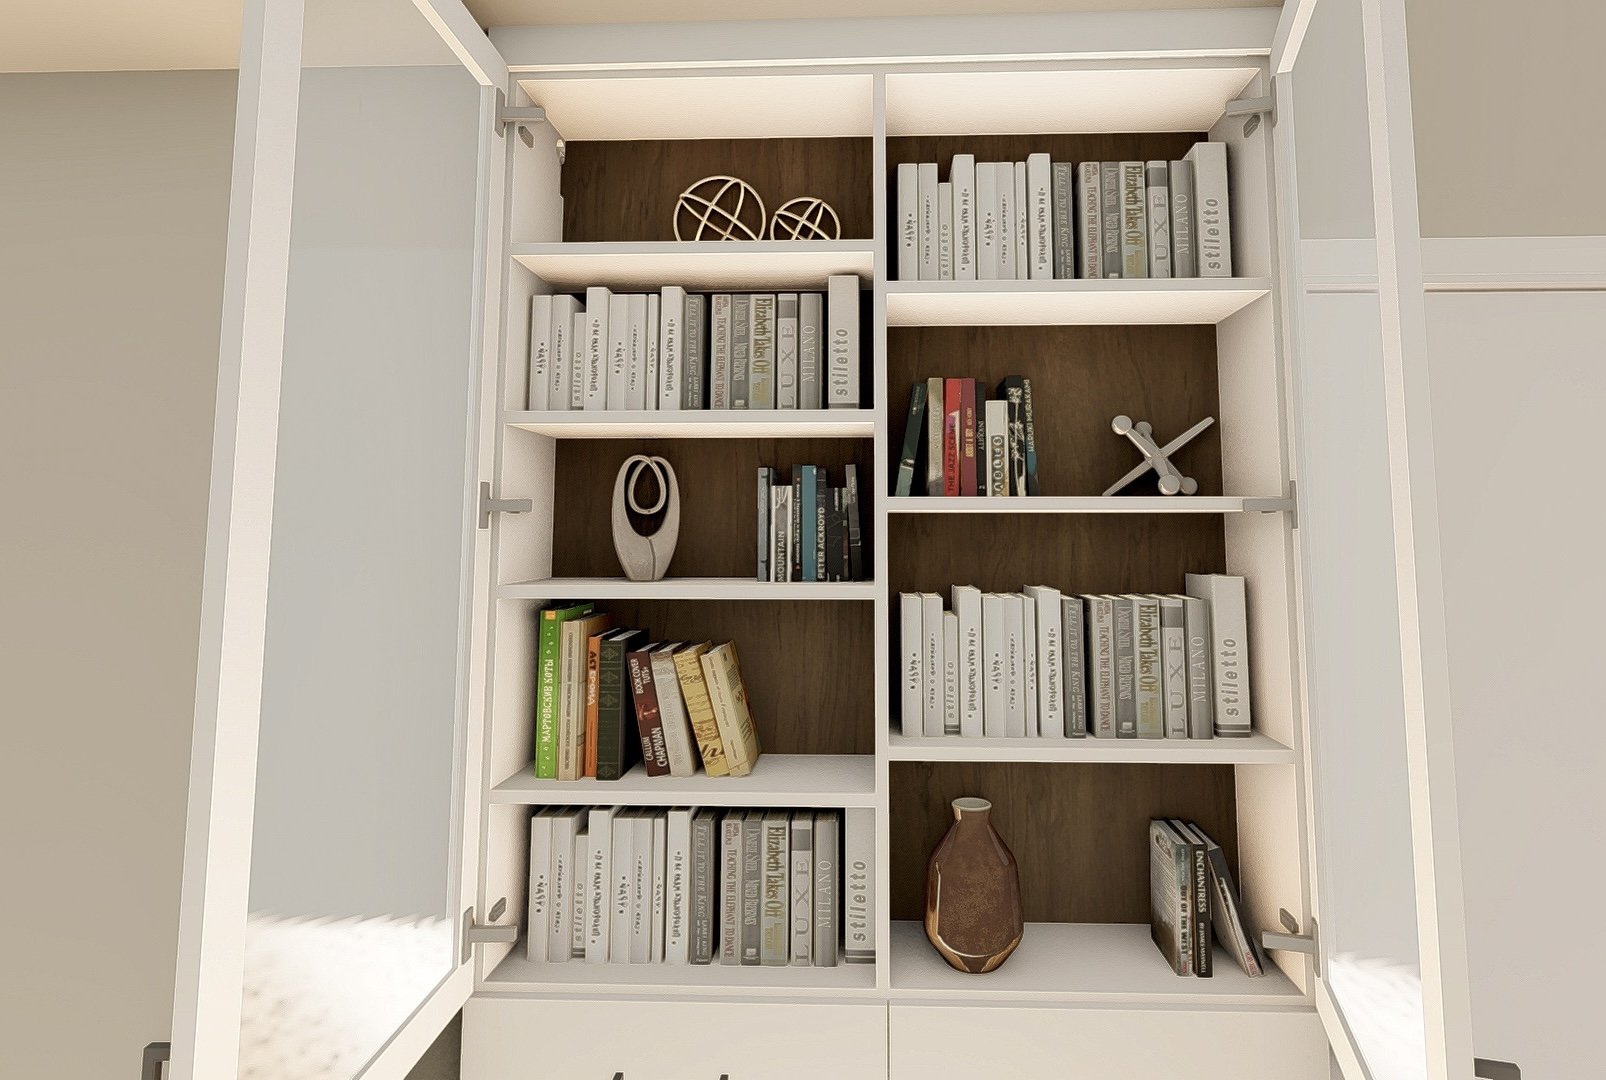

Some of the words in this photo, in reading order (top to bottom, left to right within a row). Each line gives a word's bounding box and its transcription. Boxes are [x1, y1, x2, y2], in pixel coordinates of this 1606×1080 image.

[1125, 165, 1144, 206] Elizabeth
[1125, 206, 1143, 230] Takes
[1175, 194, 1189, 255] MILANO
[1125, 230, 1143, 246] Off
[1203, 198, 1221, 270] stiletto
[754, 298, 773, 336] Elizabeth
[753, 336, 772, 359] Takes
[802, 325, 815, 382] MILANO
[752, 360, 771, 374] Off
[831, 329, 848, 397] stiletto
[1023, 379, 1033, 421] MURAKAMI
[948, 423, 956, 451] SCENE
[1026, 422, 1035, 452] HARUKI
[947, 475, 955, 492] THE
[817, 507, 825, 550] ACKROYD
[776, 531, 785, 581] MOUNTAIN
[817, 551, 825, 579] PETER
[1069, 604, 1079, 626] TELL
[1139, 604, 1157, 648] Elizabeth
[1100, 625, 1110, 656] TEACHING
[544, 659, 554, 682] КОТЫ
[630, 658, 641, 677] COVER
[1071, 652, 1079, 668] THE
[1100, 657, 1110, 670] THE
[1139, 649, 1157, 675] Takes
[1191, 636, 1207, 702] MILANO
[633, 677, 644, 695] BOOK
[1071, 670, 1081, 693] KING
[1100, 671, 1110, 700] ELEPHANT
[1139, 675, 1158, 692] Off
[1169, 636, 1185, 735] LUXE
[1220, 638, 1240, 716] stiletto
[1100, 711, 1110, 730] DANCE
[642, 736, 654, 761] CALLUM
[651, 727, 668, 767] CHAPMAN
[697, 825, 707, 848] TELL
[767, 826, 786, 871] Elizabeth
[697, 862, 707, 873] TO
[726, 849, 737, 880] TEACHING
[697, 875, 707, 892] THE
[726, 881, 737, 892] THE
[766, 873, 785, 899] Takes
[817, 860, 832, 928] MILANO
[1180, 885, 1188, 902] OUT
[1195, 850, 1206, 913] ENCHANTRESS
[697, 895, 708, 918] KING
[725, 895, 736, 925] ELEPHANT
[765, 900, 785, 918] Off
[795, 860, 809, 962] LUXE
[849, 861, 867, 942] stiletto
[1180, 903, 1188, 913] OF
[724, 936, 734, 958] DANCE
